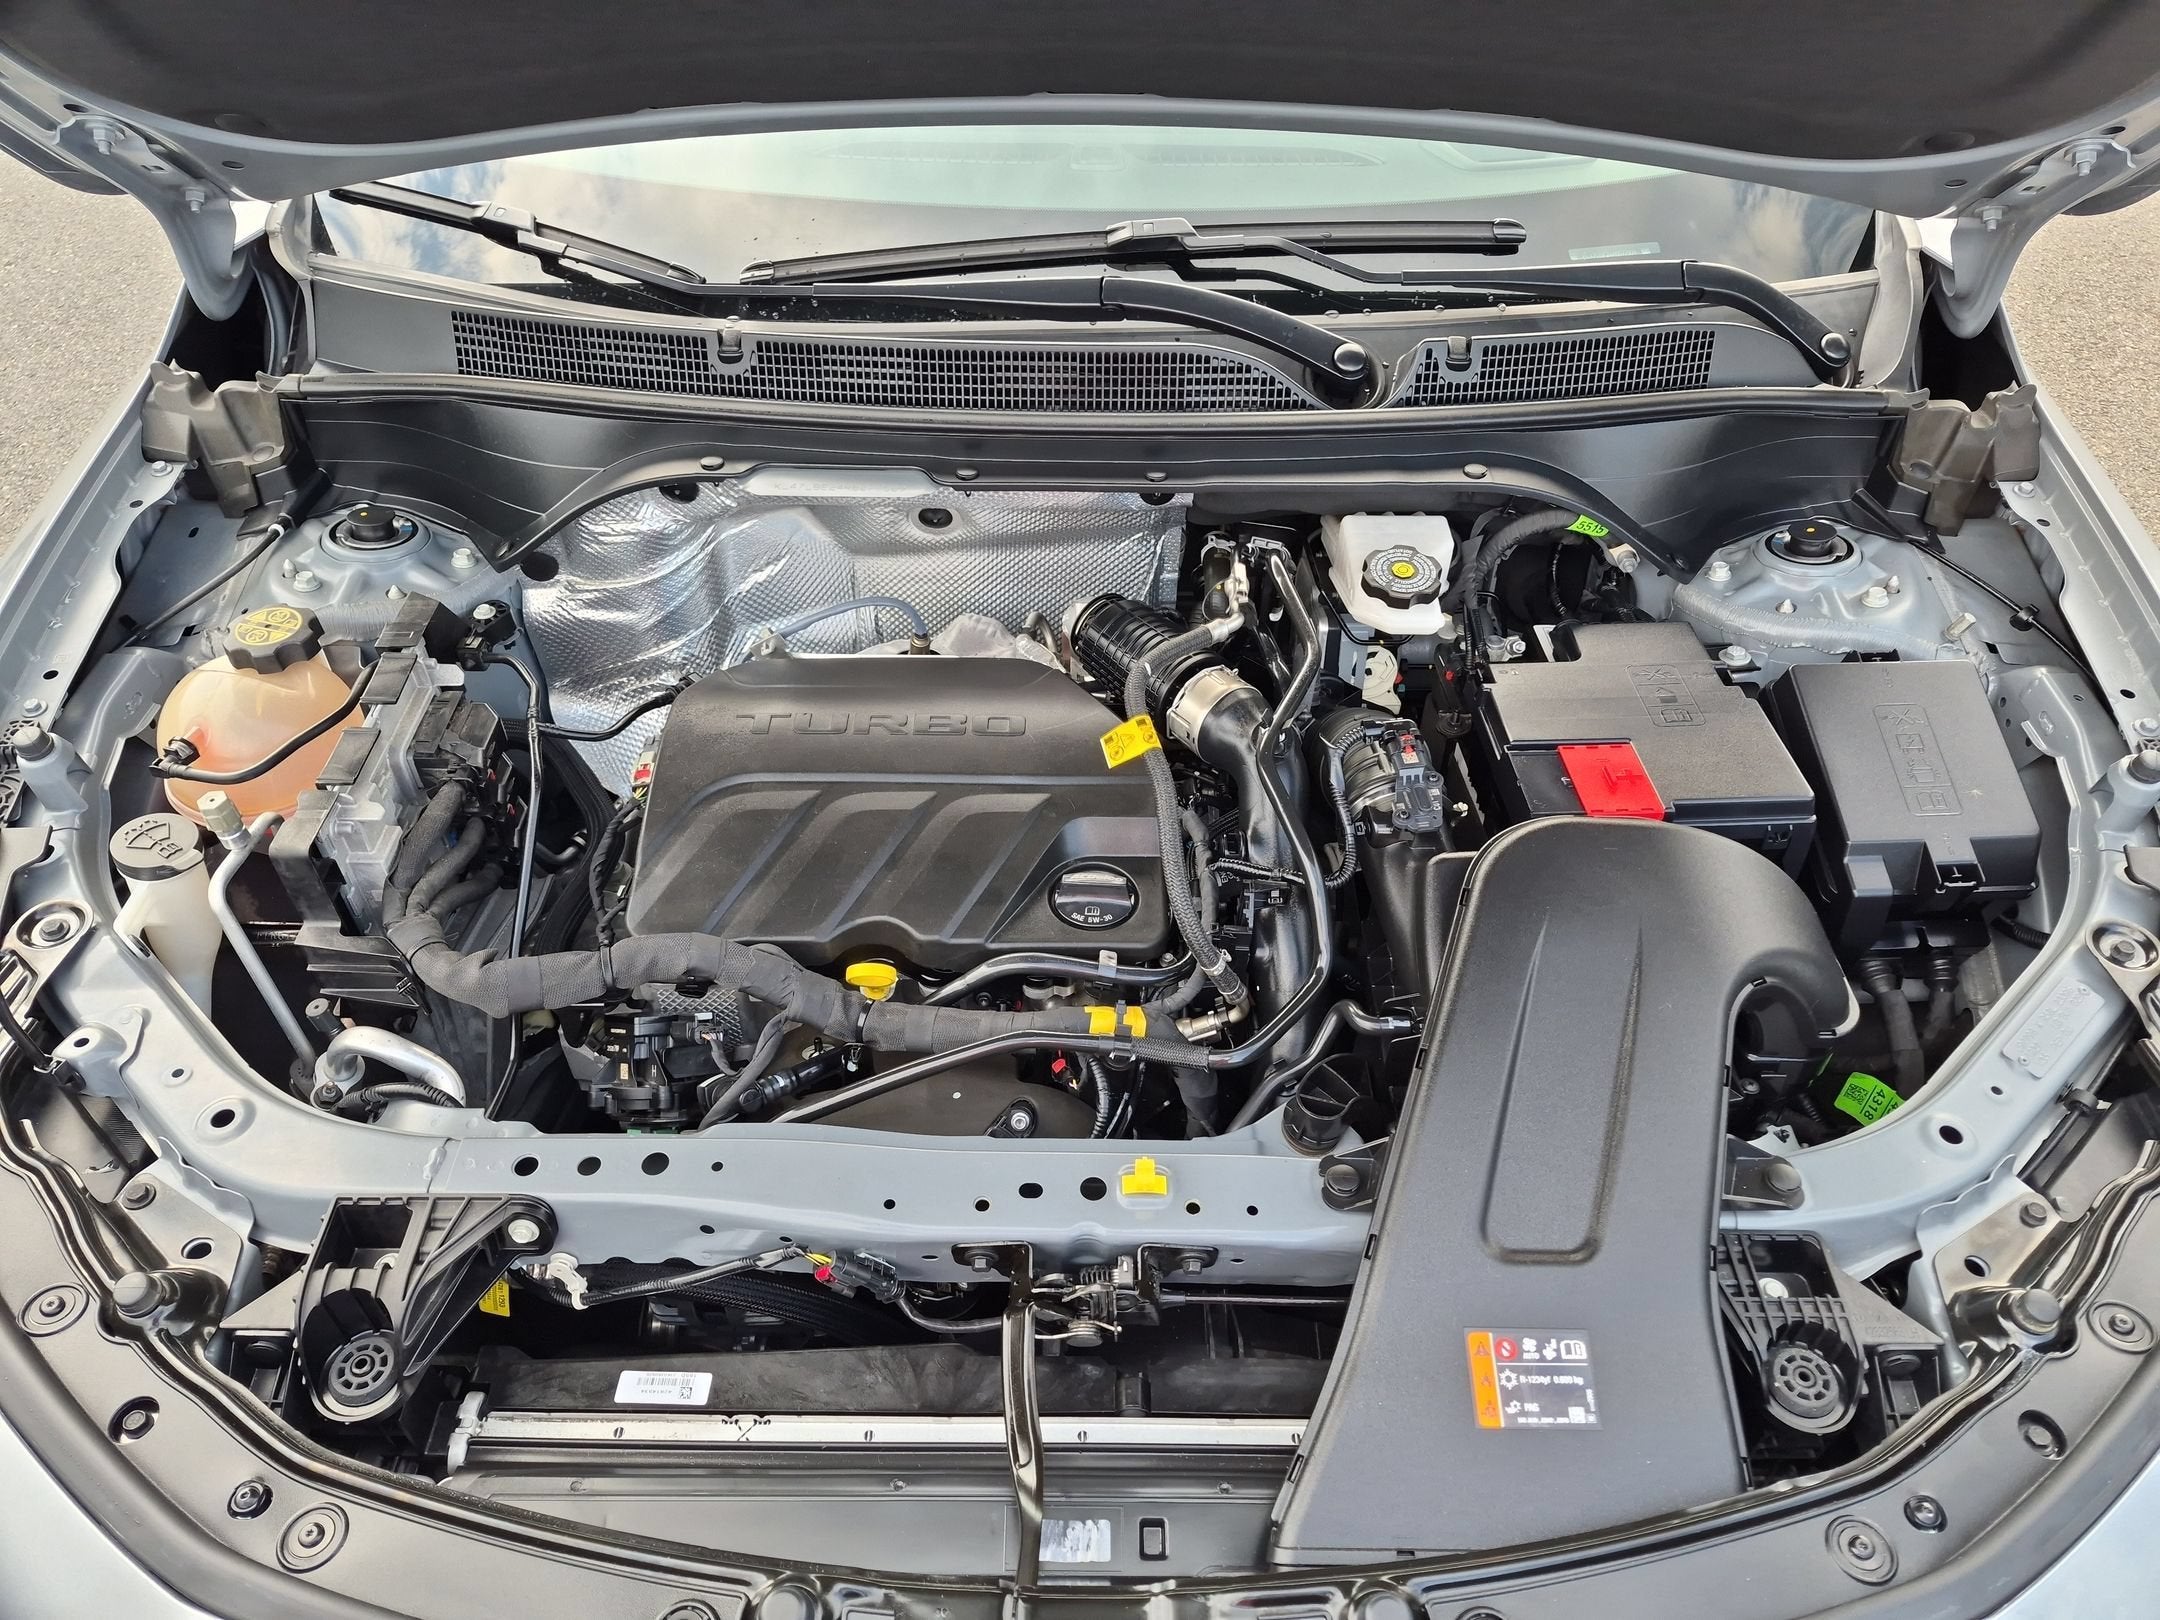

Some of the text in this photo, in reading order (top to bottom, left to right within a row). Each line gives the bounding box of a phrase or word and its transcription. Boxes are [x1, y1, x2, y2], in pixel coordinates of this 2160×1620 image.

[736, 712, 1027, 736] TURBO
[1071, 912, 1113, 923] SAE 5W-30
[1863, 1089, 1886, 1120] 4318
